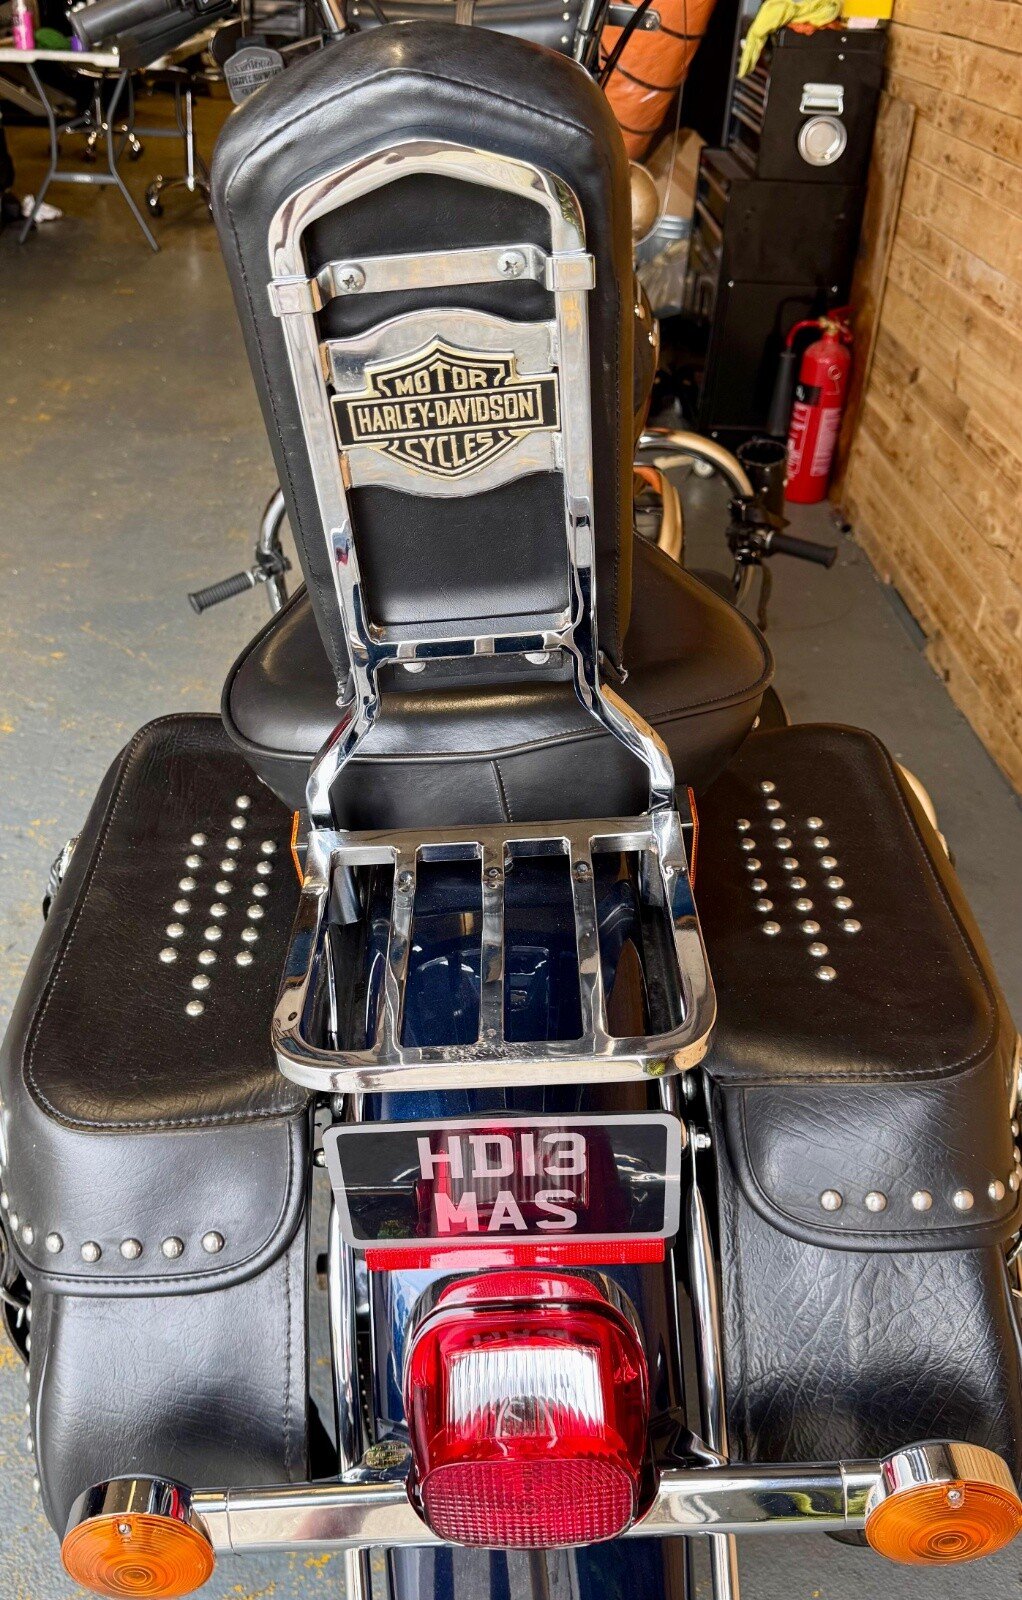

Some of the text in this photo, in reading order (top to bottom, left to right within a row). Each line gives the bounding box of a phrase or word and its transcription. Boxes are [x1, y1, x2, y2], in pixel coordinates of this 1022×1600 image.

[395, 360, 489, 396] MOTOR
[356, 391, 535, 434] HARLEY-DAVIDSON
[404, 430, 494, 468] CYCLES
[434, 1189, 578, 1233] MAS
